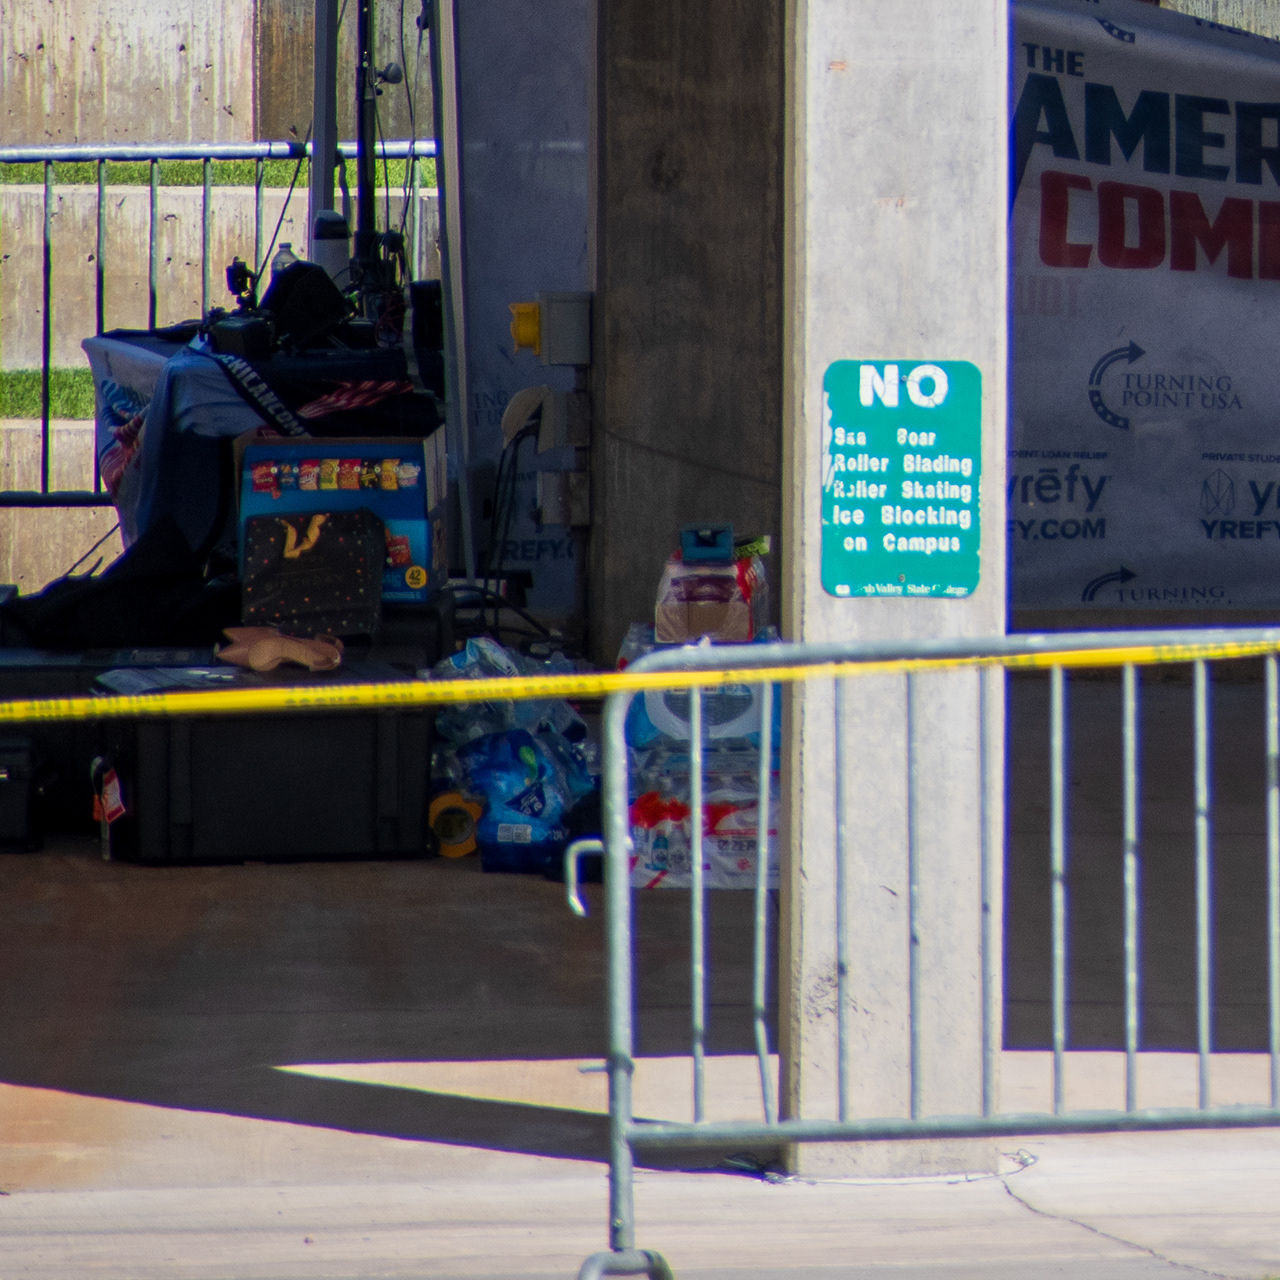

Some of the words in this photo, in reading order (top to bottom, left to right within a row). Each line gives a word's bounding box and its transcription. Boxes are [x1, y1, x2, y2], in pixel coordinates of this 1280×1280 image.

[1022, 42, 1085, 77] THE
[859, 364, 949, 408] NO
[1121, 373, 1233, 392] TURNING
[1121, 391, 1195, 409] POINT
[1200, 393, 1243, 410] USA
[834, 453, 890, 473] Roller
[903, 453, 973, 478] Blading
[1201, 452, 1245, 463] PRIVATE
[901, 480, 972, 504] Skating
[832, 505, 865, 525] Ice
[881, 505, 972, 530] Blocking
[843, 536, 868, 552] on
[883, 532, 961, 555] Campus
[875, 583, 904, 598] Valley
[907, 583, 931, 597] State
